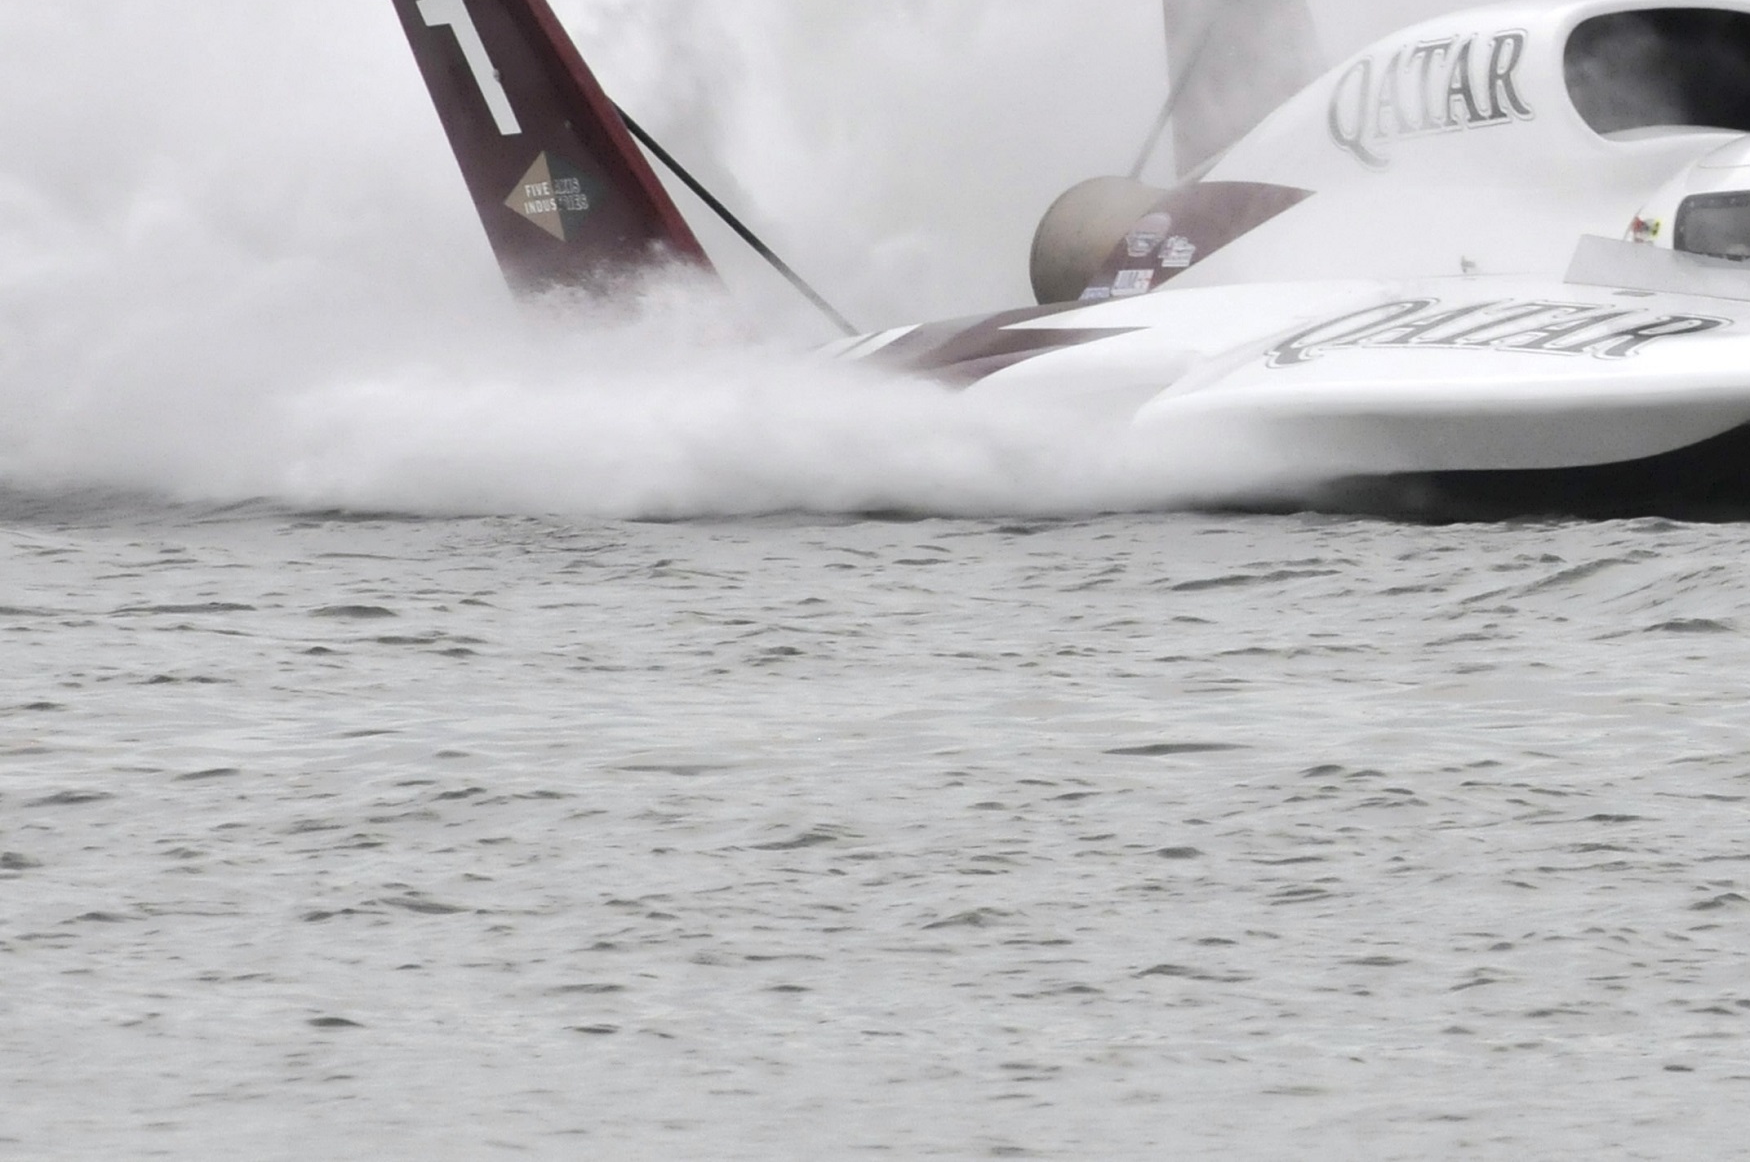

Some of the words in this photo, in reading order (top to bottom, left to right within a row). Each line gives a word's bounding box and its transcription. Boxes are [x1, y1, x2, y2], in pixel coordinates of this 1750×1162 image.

[1327, 28, 1535, 172] QATAR
[524, 181, 551, 197] FIVE
[1266, 298, 1733, 368] QATAR
